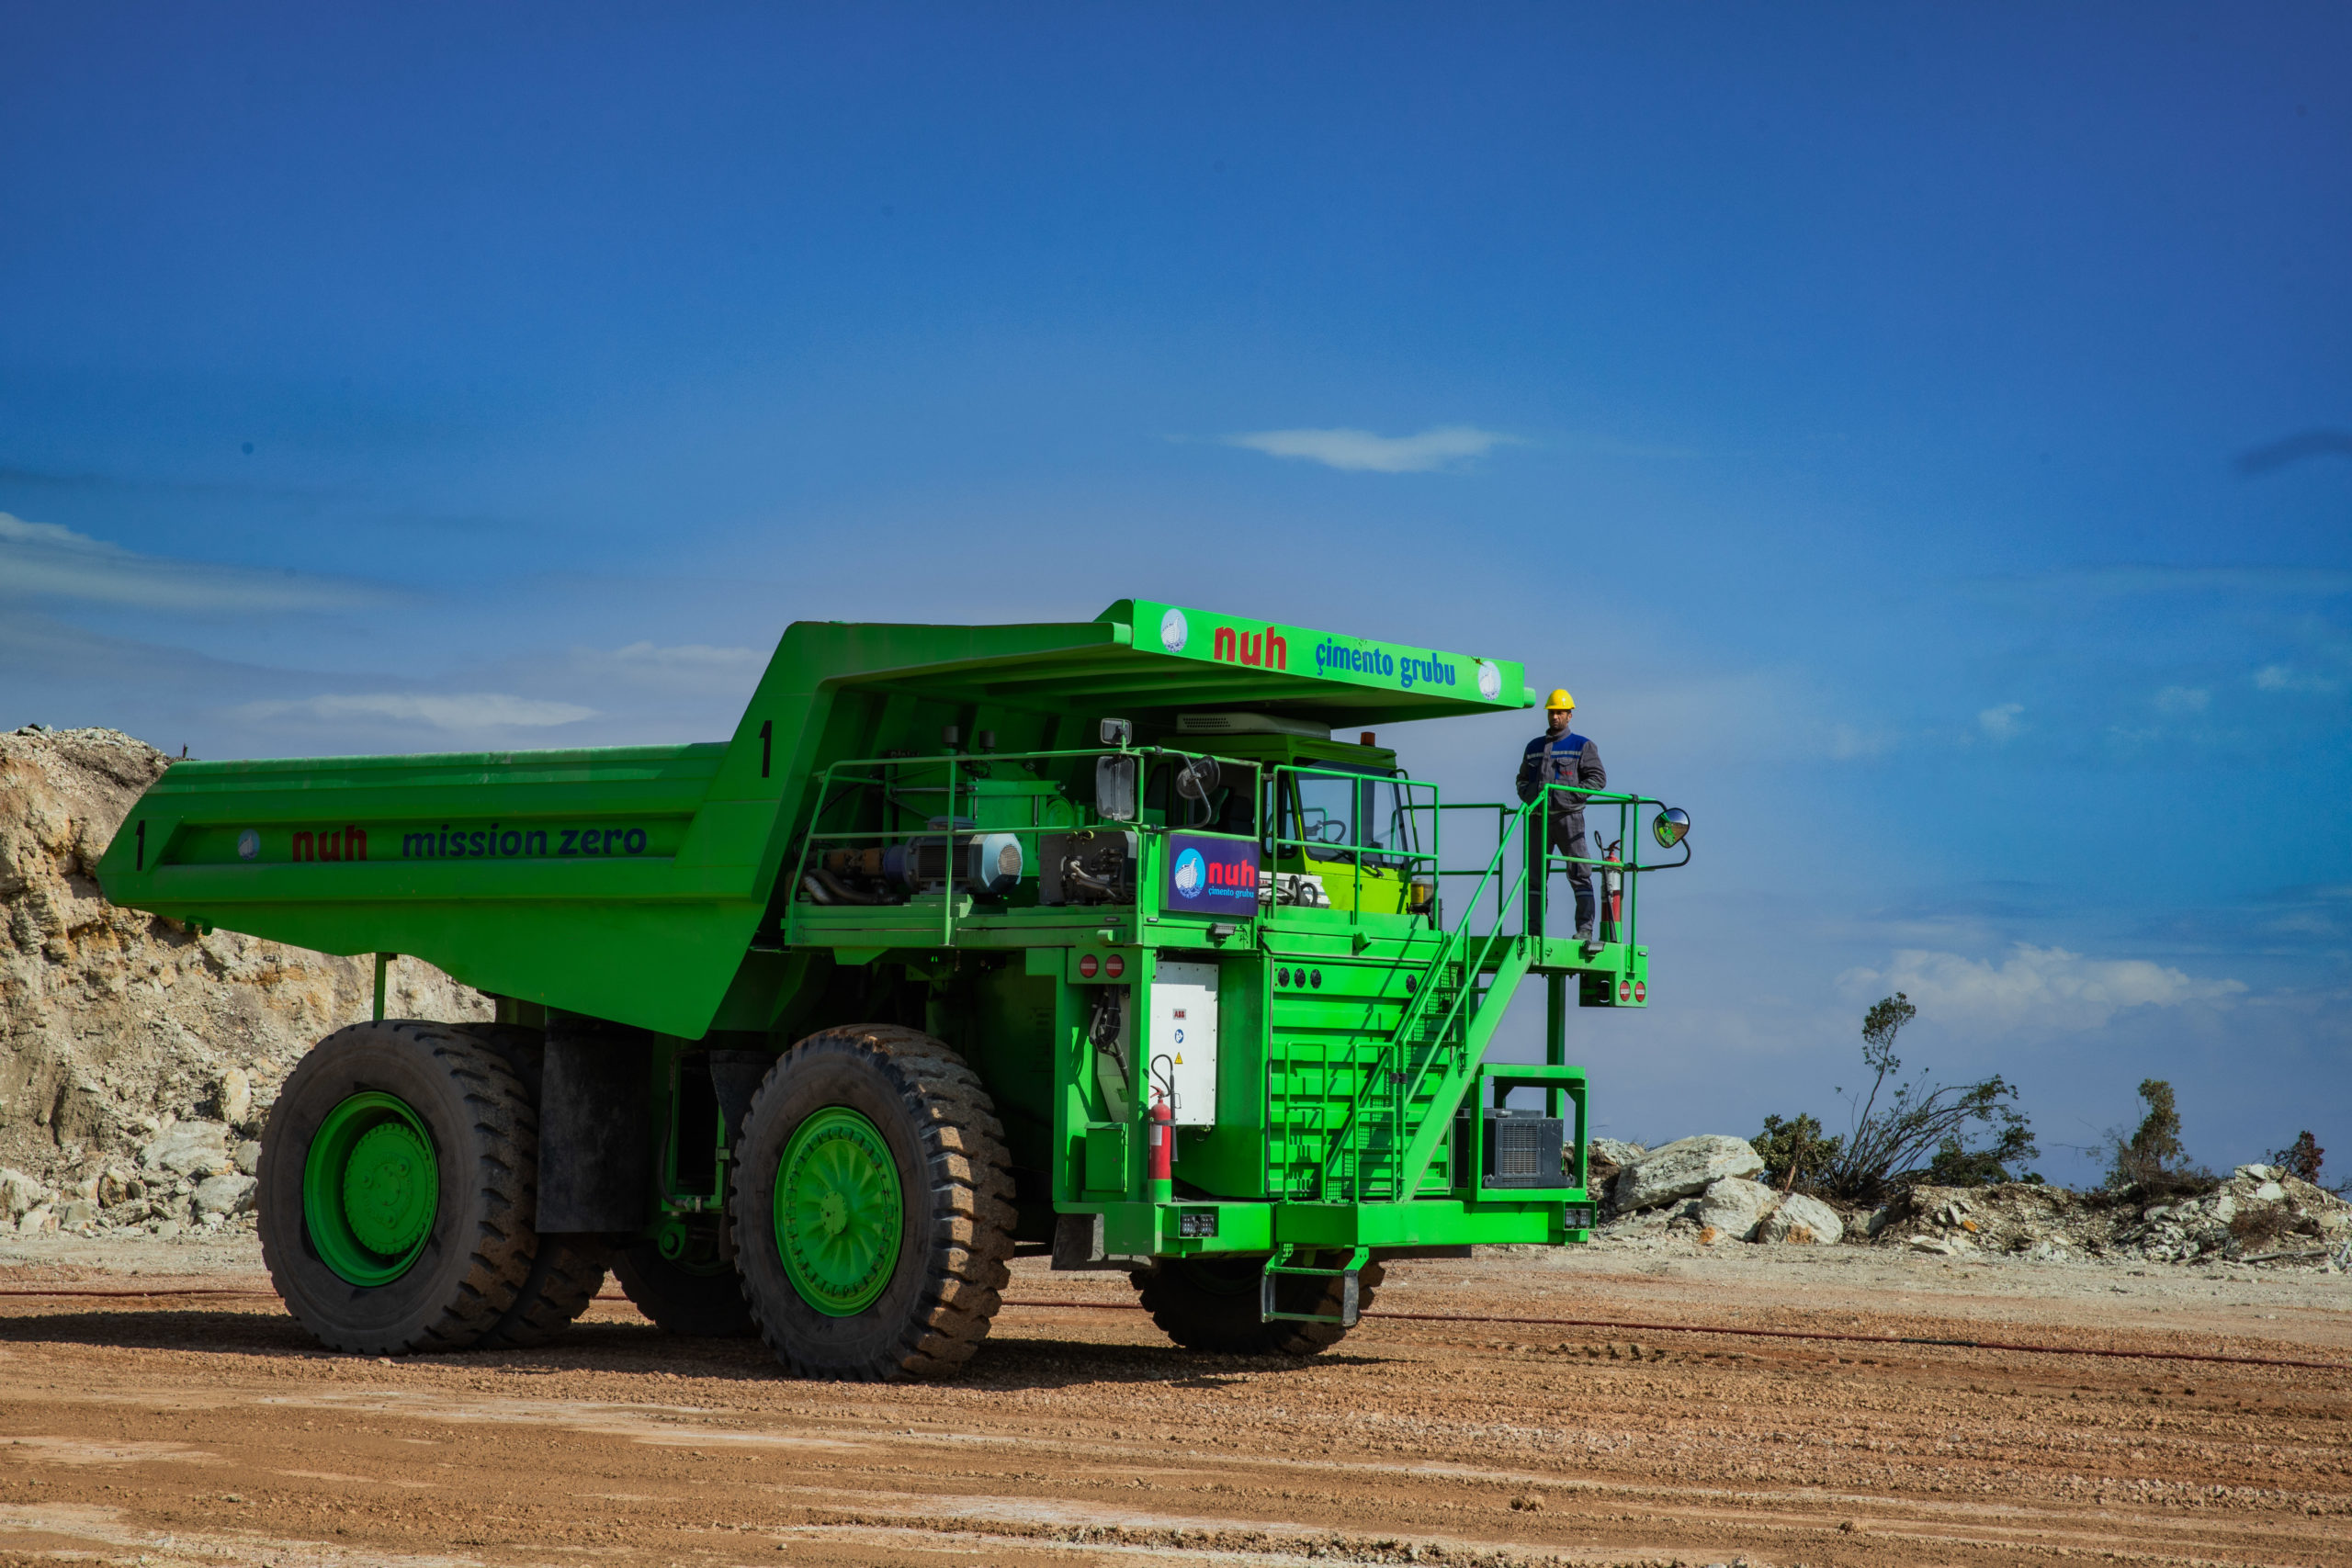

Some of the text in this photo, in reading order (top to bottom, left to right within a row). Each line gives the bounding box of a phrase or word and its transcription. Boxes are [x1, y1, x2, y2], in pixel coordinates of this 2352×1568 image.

[1214, 626, 1287, 671] nuh
[1315, 637, 1456, 689] çimento grubu
[758, 719, 773, 779] 1
[134, 819, 146, 872] 1
[292, 824, 368, 863] nuh
[402, 823, 648, 859] mission zero
[1208, 859, 1255, 887] nuh
[1208, 886, 1255, 899] çimento grubu
